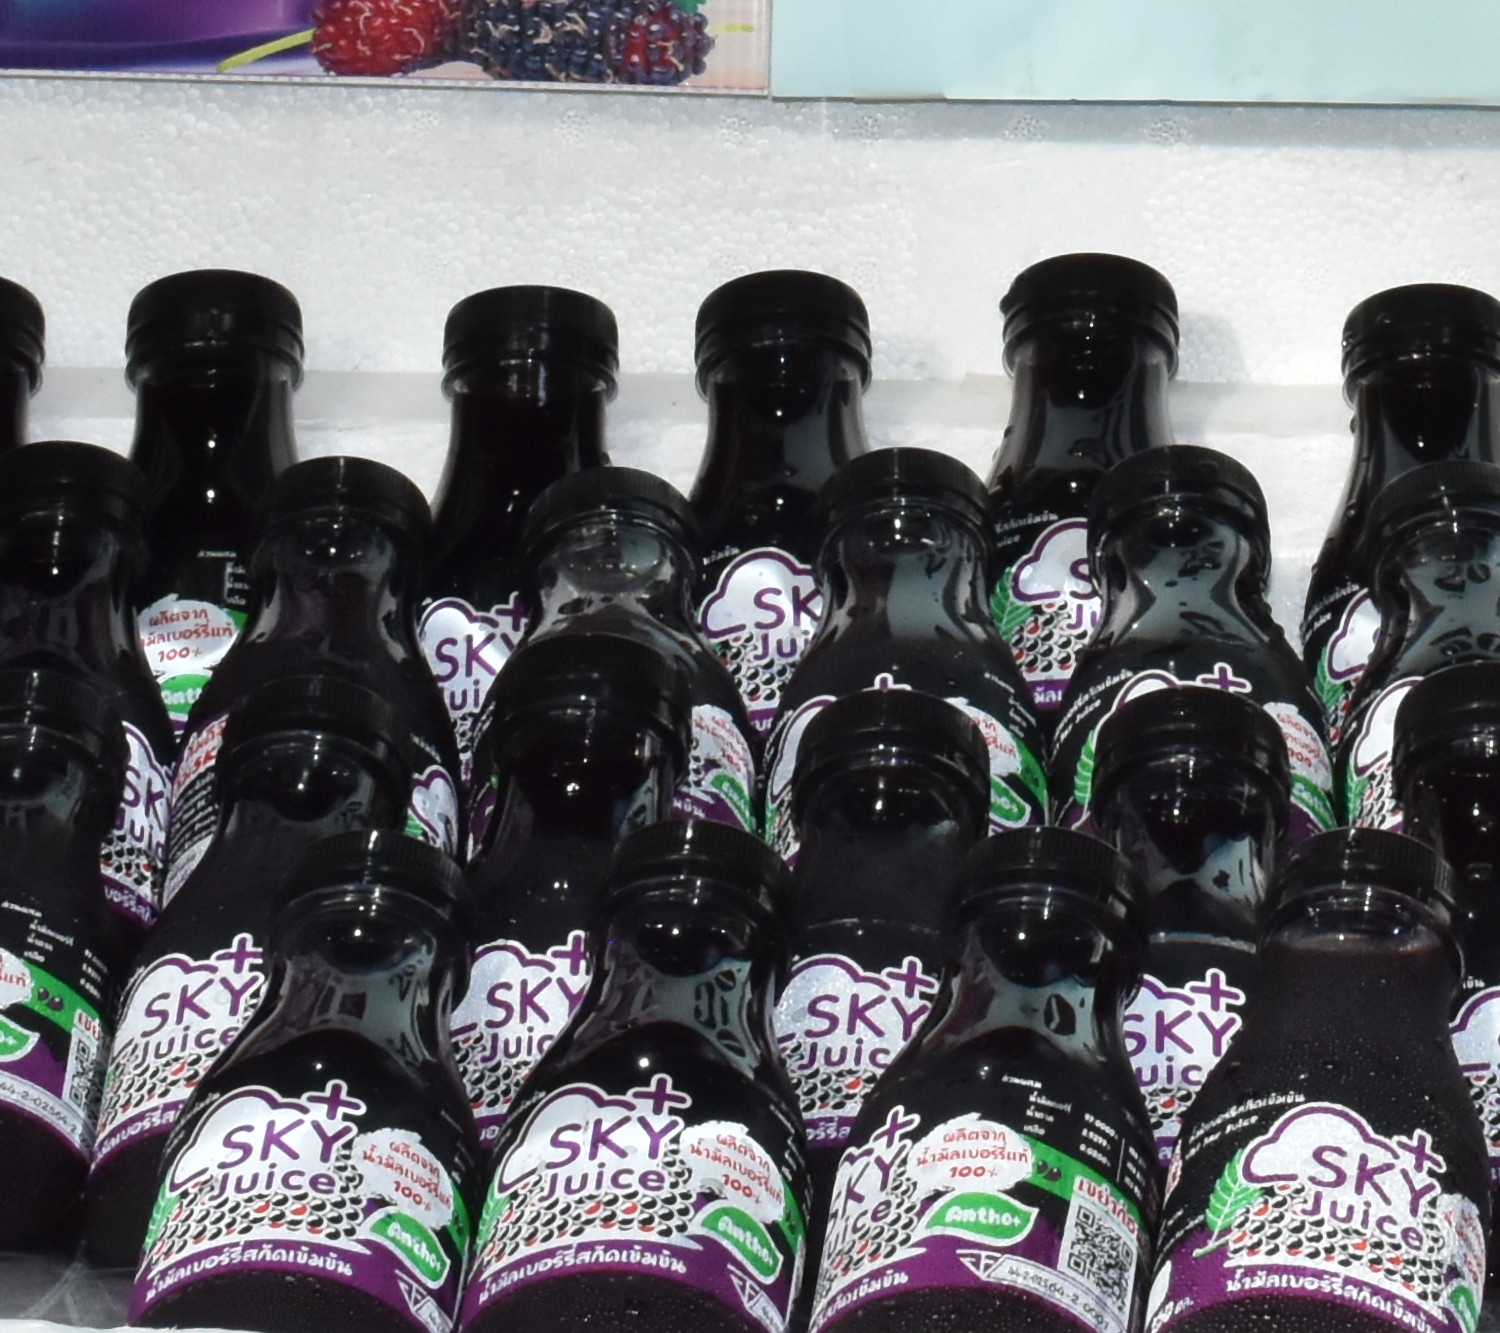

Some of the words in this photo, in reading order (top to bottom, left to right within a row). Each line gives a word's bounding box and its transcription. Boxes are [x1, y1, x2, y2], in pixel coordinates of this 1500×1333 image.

[942, 1128, 1008, 1144] ผลิตจาก
[207, 1162, 337, 1202] Juice
[537, 1162, 667, 1203] Juice
[944, 1205, 1022, 1227] Antho+
[1299, 1190, 1424, 1251] Juice
